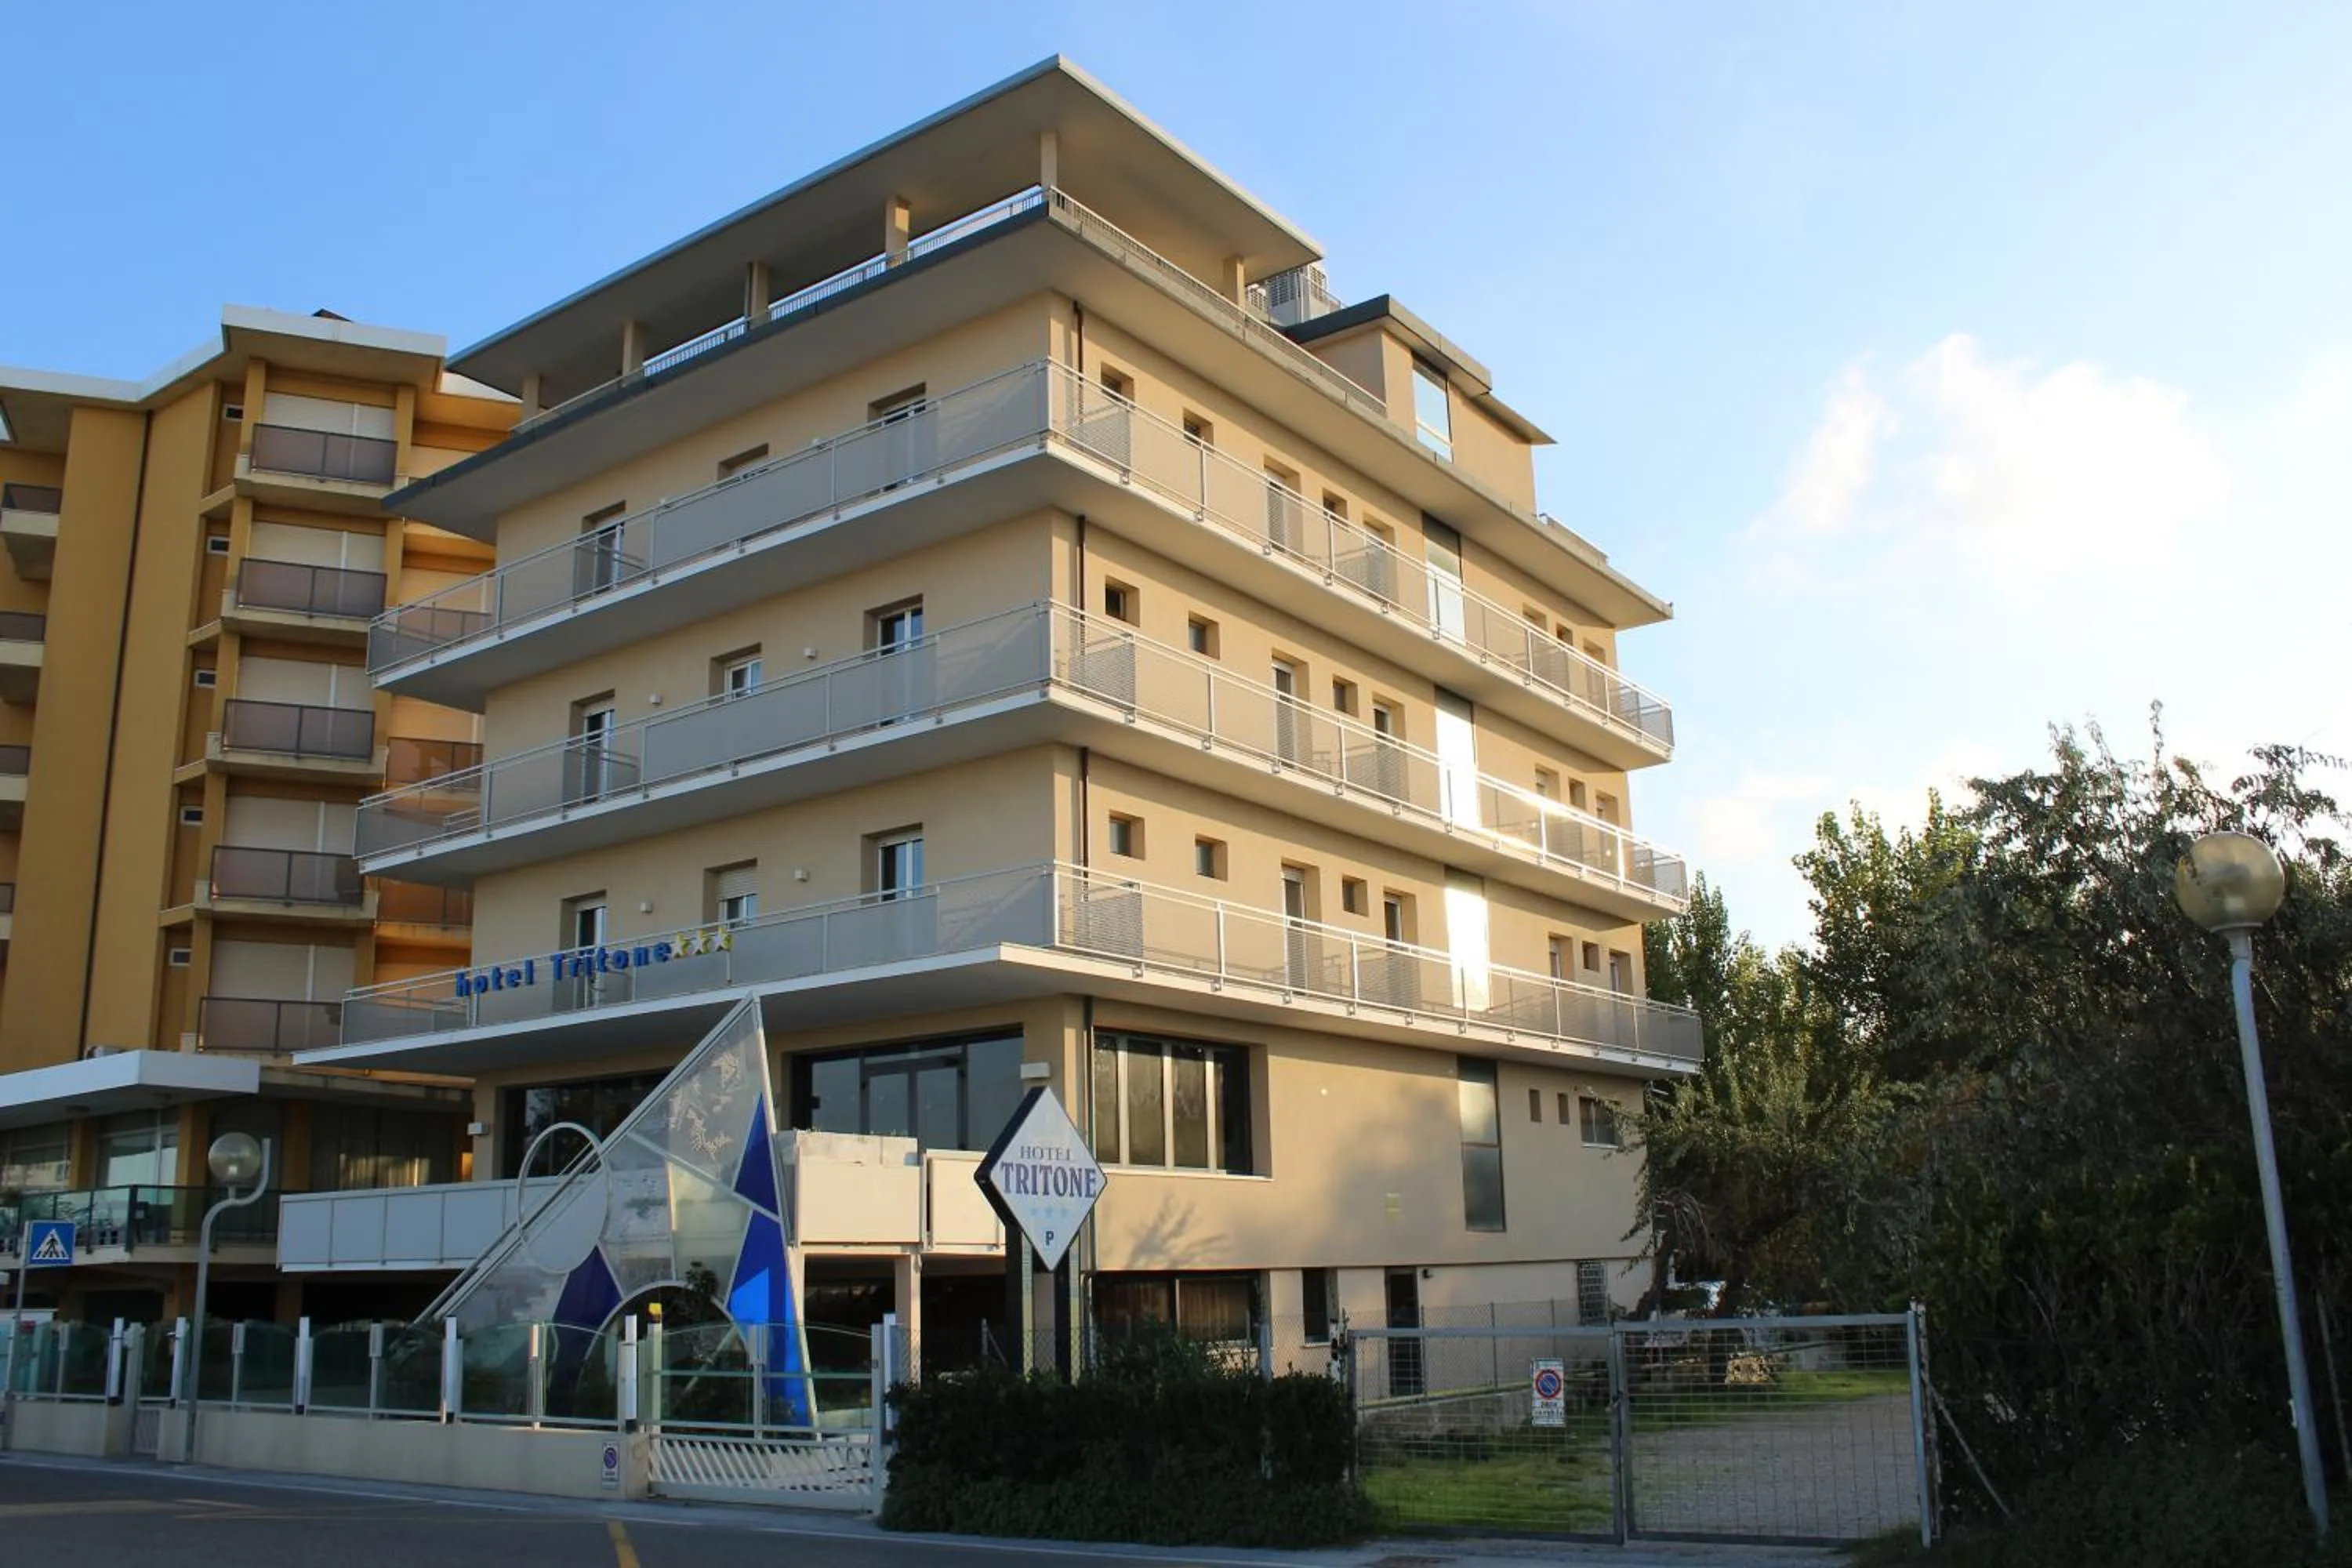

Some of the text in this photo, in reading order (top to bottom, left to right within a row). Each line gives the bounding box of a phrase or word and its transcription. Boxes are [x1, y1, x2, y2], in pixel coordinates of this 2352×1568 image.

[456, 942, 673, 997] hotel Tritone
[1020, 1145, 1075, 1161] HOTEL
[1001, 1161, 1096, 1198] TRITONE
[1045, 1230, 1054, 1246] P
